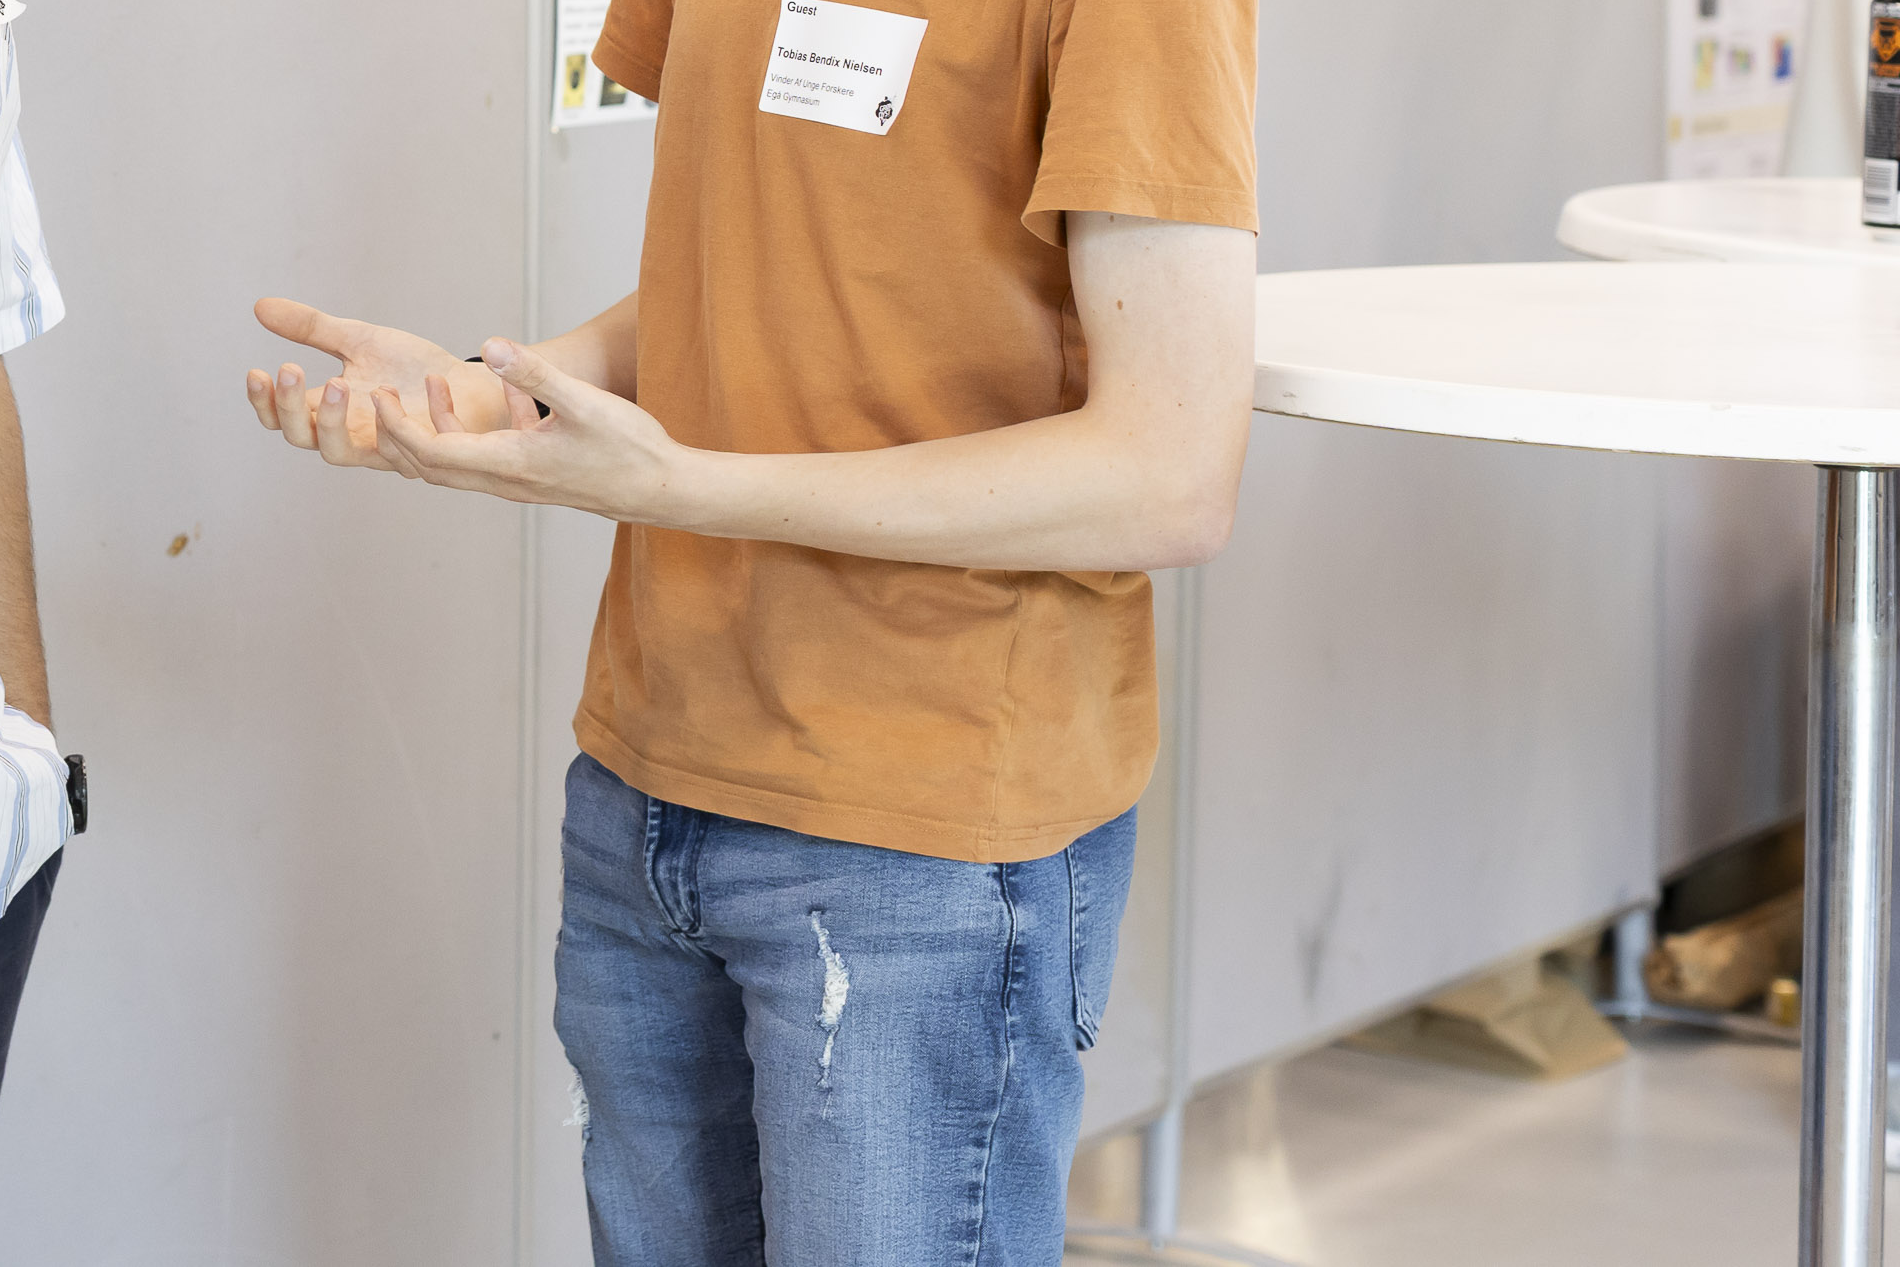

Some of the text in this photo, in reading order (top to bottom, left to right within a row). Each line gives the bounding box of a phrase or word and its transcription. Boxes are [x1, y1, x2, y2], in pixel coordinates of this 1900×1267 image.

[787, 1, 817, 16] Guest
[777, 46, 883, 76] Tobias Bendix Nielsen
[771, 73, 794, 86] Vinder
[803, 79, 820, 91] Unge
[821, 82, 855, 97] Forskere
[783, 92, 820, 107] Gymnasium
